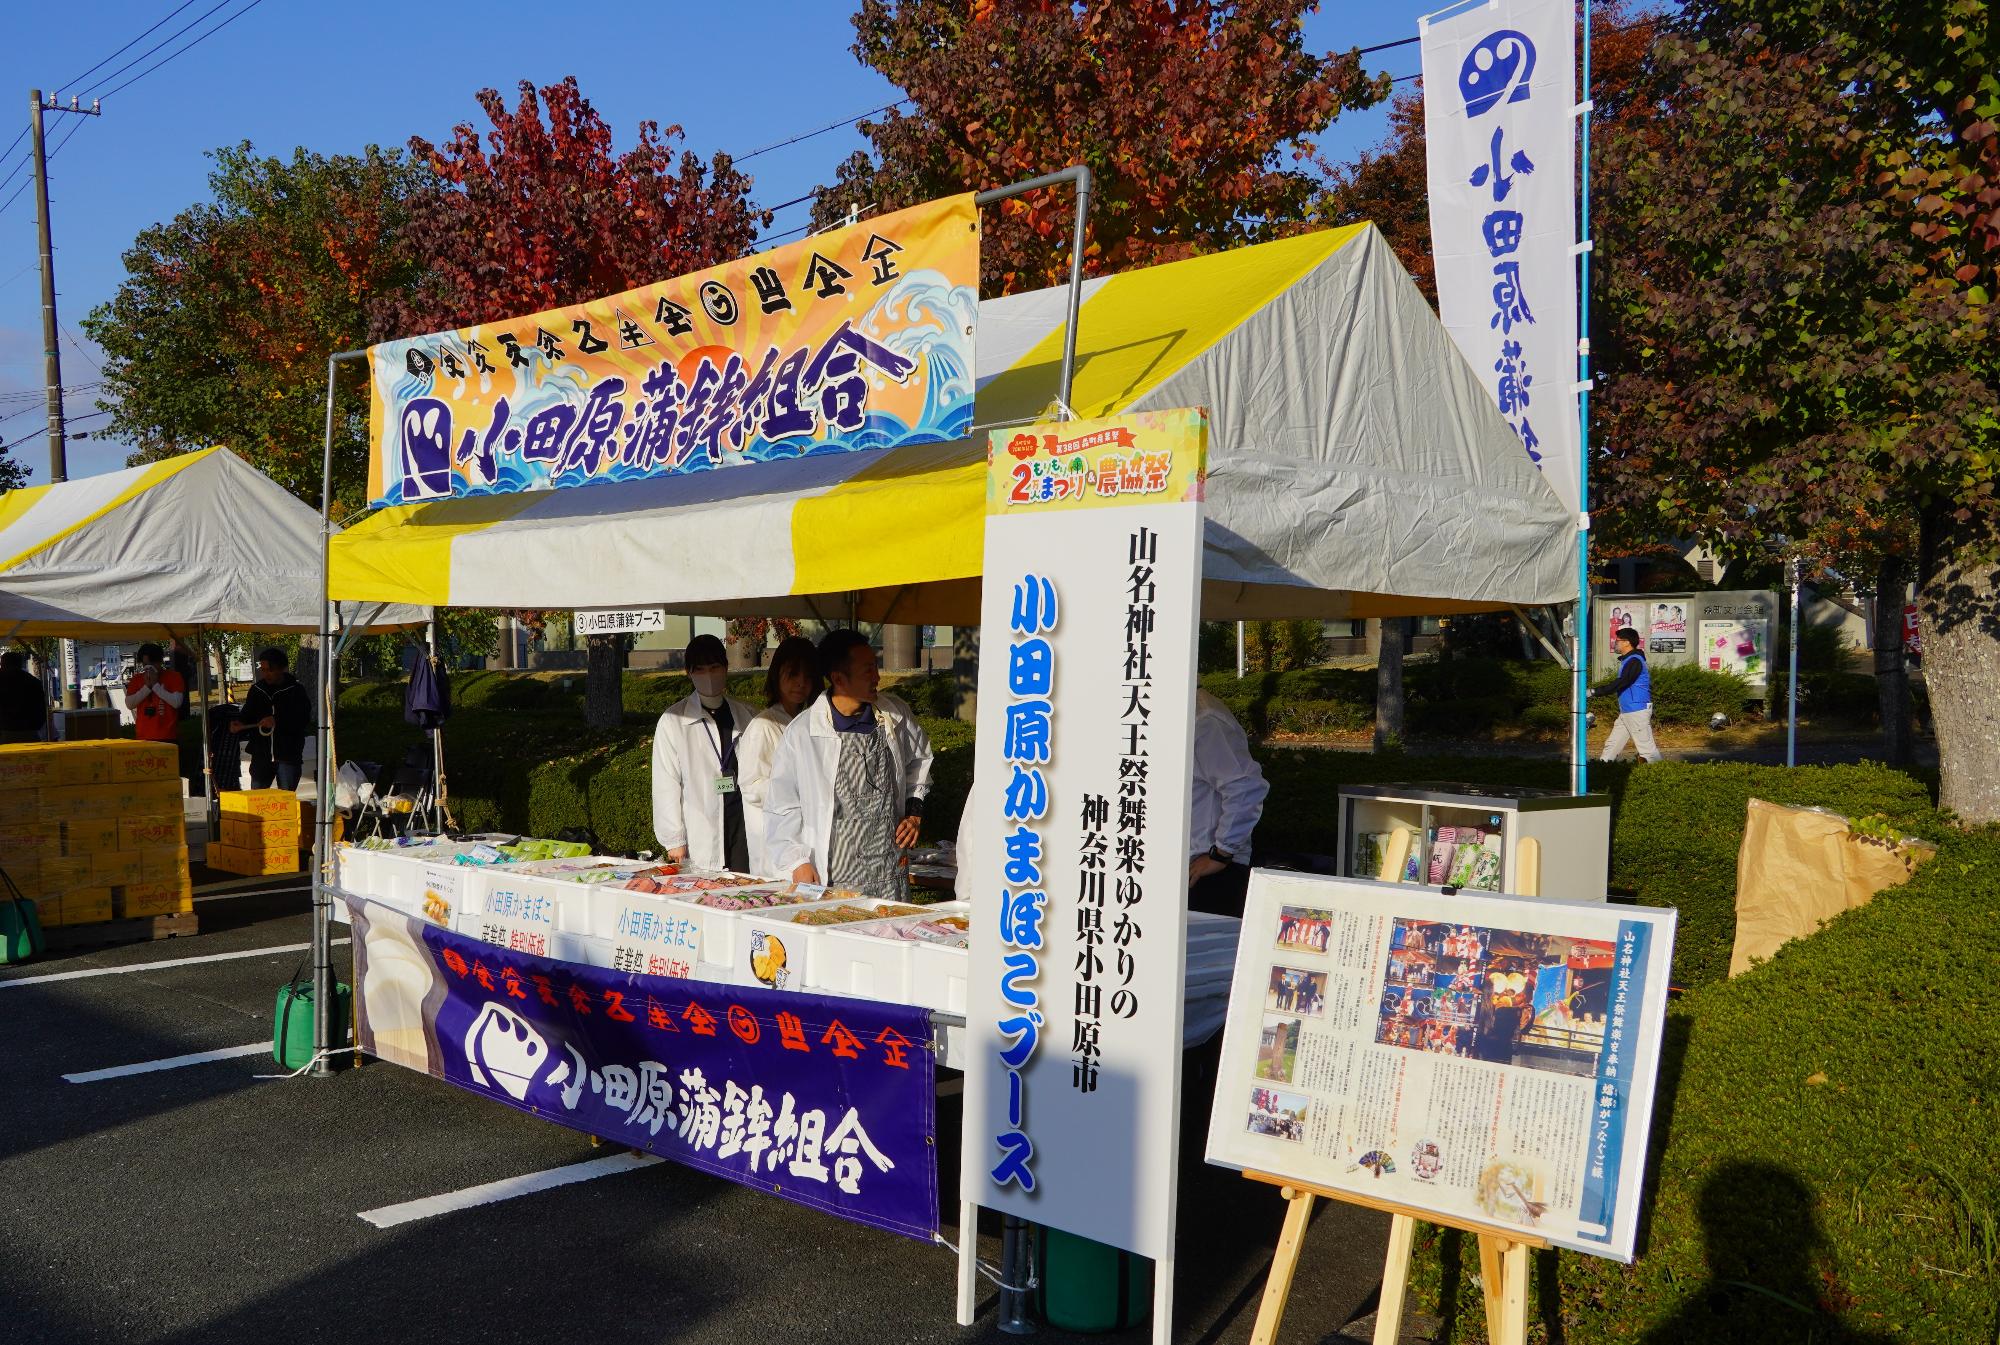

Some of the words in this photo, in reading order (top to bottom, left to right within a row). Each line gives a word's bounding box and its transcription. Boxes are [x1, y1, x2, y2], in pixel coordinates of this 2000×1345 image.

[458, 321, 914, 484] 小田原蒲鉾組合
[1110, 526, 1158, 1020] 山名神社天王祭舞楽ゆかりの
[487, 888, 551, 923] 小田原かまぼこ
[618, 907, 697, 950] 小田原かまぼこ
[992, 574, 1057, 1193] 小田原かまぼこブース
[1071, 793, 1109, 1093] 神奈川県小田原市
[545, 1041, 895, 1195] 小田原蒲鉾組合
